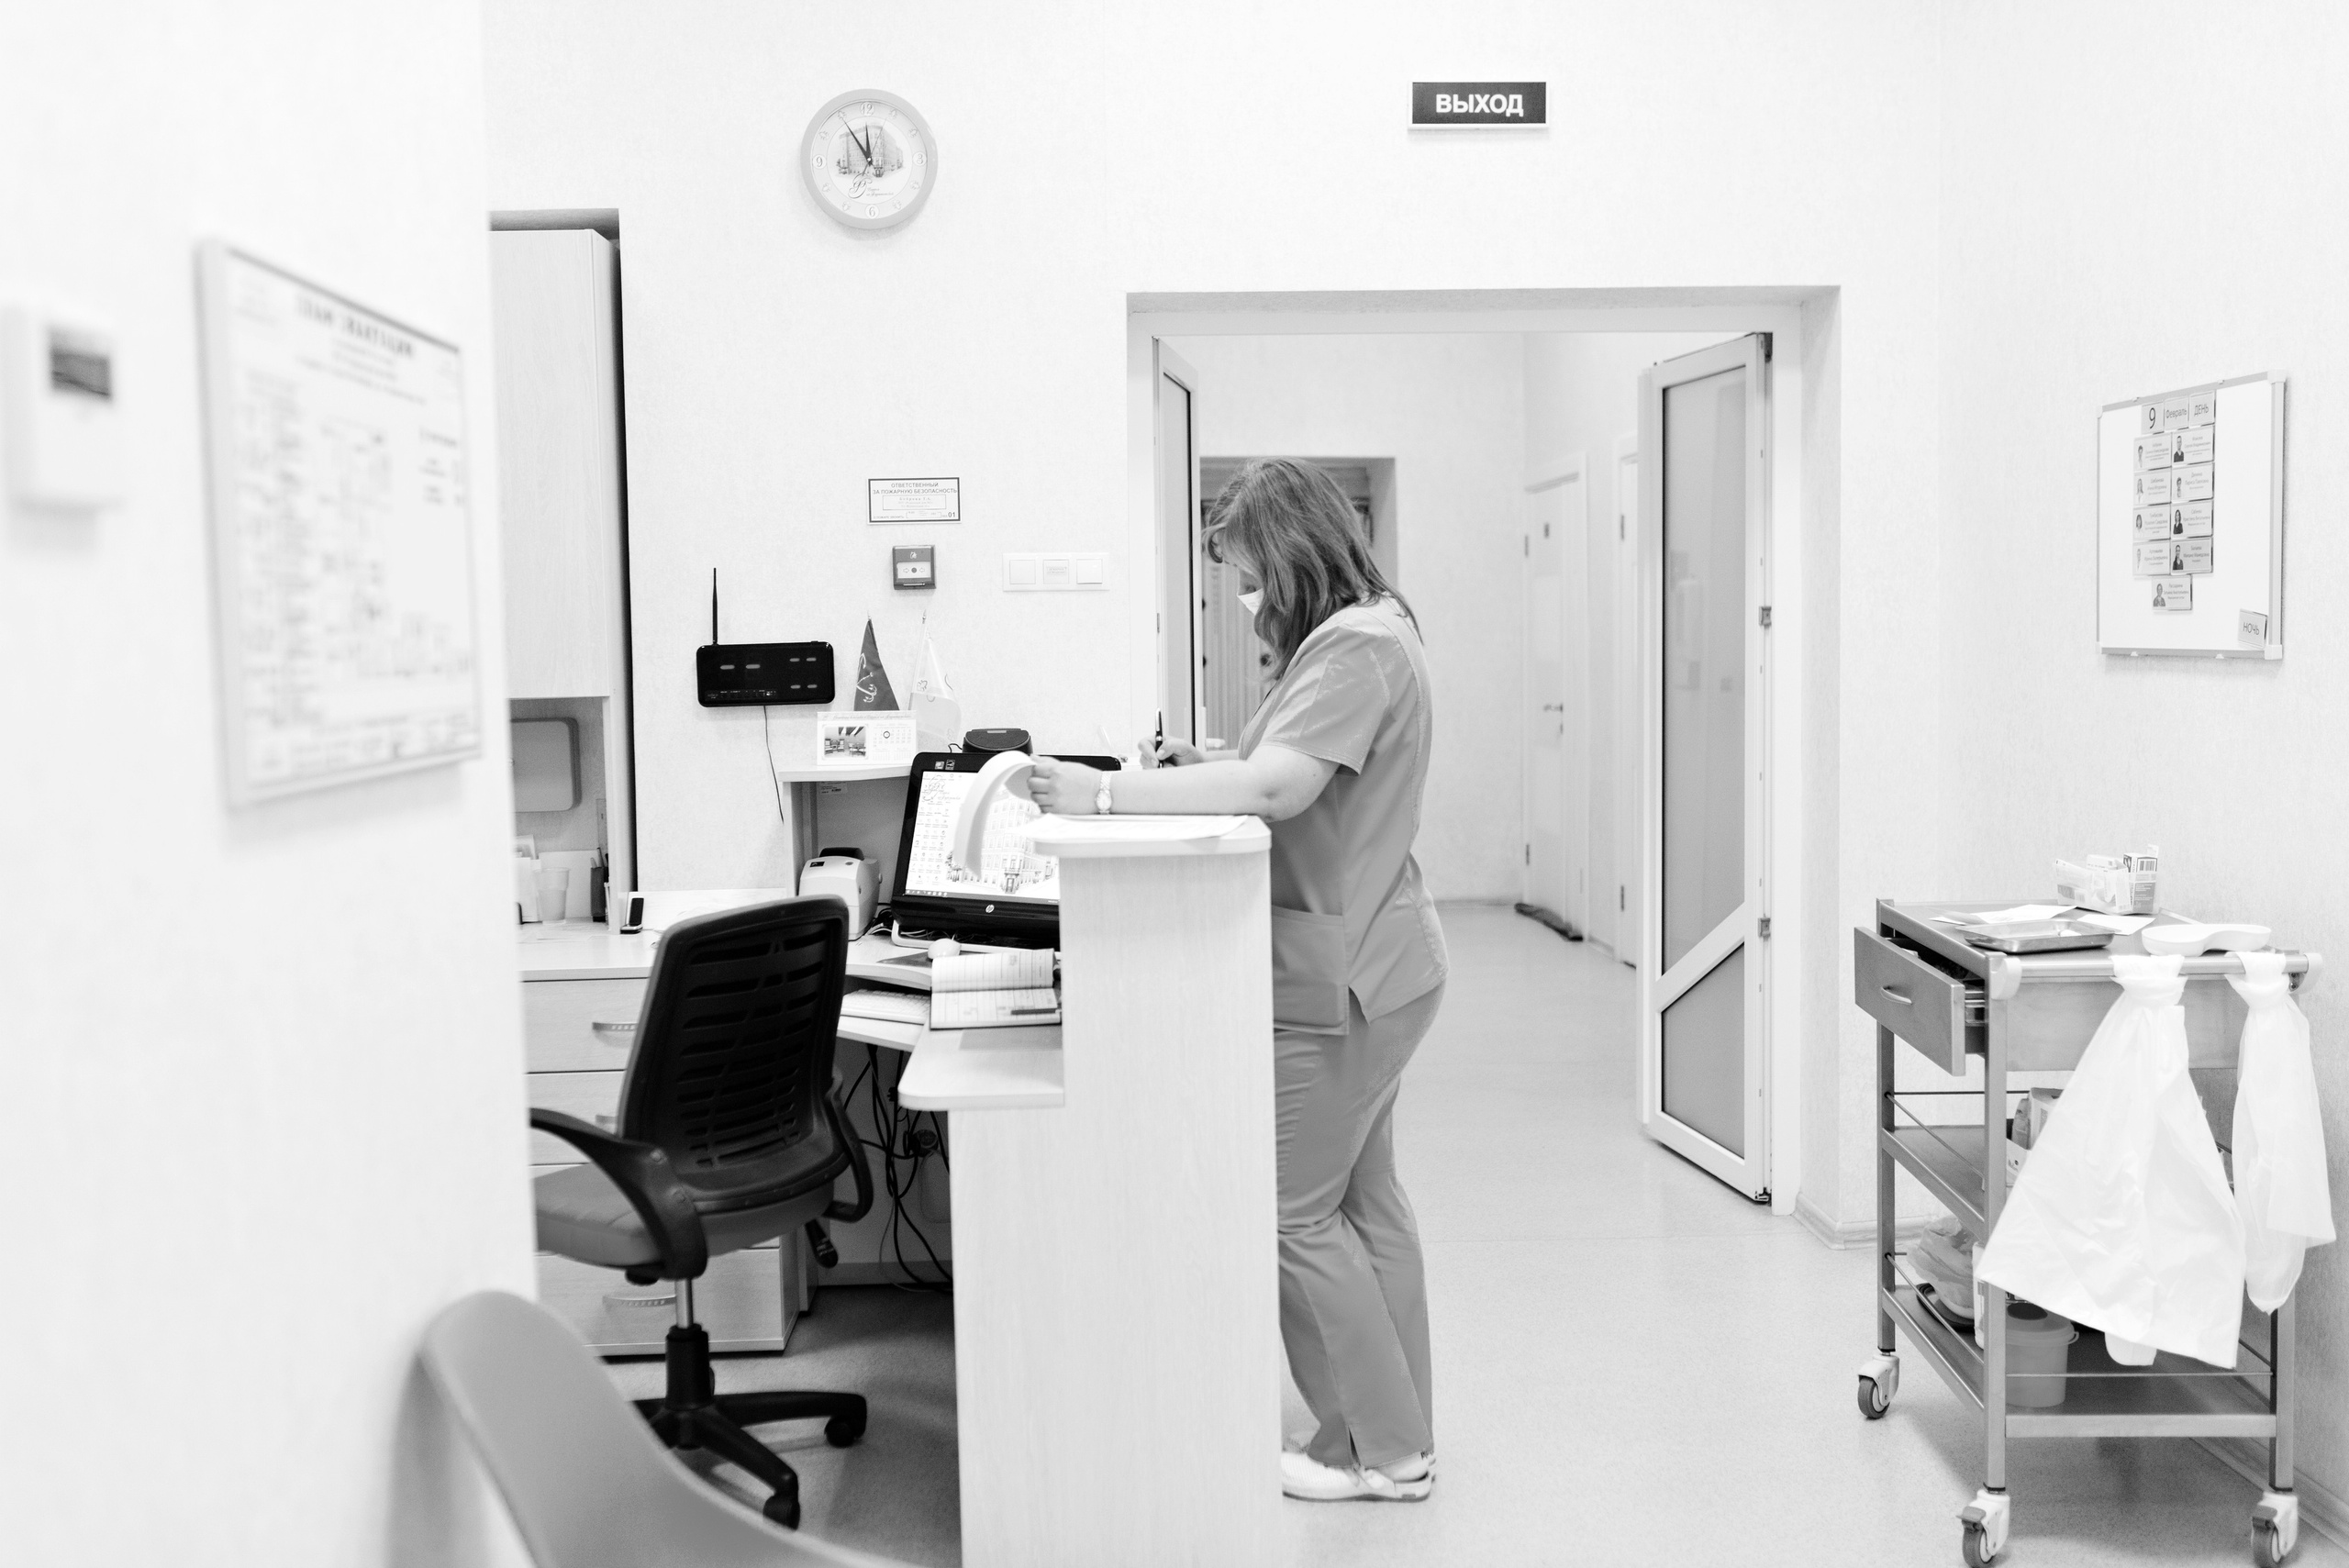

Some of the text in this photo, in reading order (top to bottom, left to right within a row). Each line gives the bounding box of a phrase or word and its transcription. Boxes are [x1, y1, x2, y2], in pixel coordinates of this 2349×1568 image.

[862, 103, 873, 116] 12
[1435, 94, 1524, 117] ВЫХОД
[816, 156, 823, 167] 9
[868, 206, 876, 217] 6
[2148, 403, 2210, 429] 9 Февраль ДЕНЬ
[2243, 621, 2260, 636] НОЧЬ
